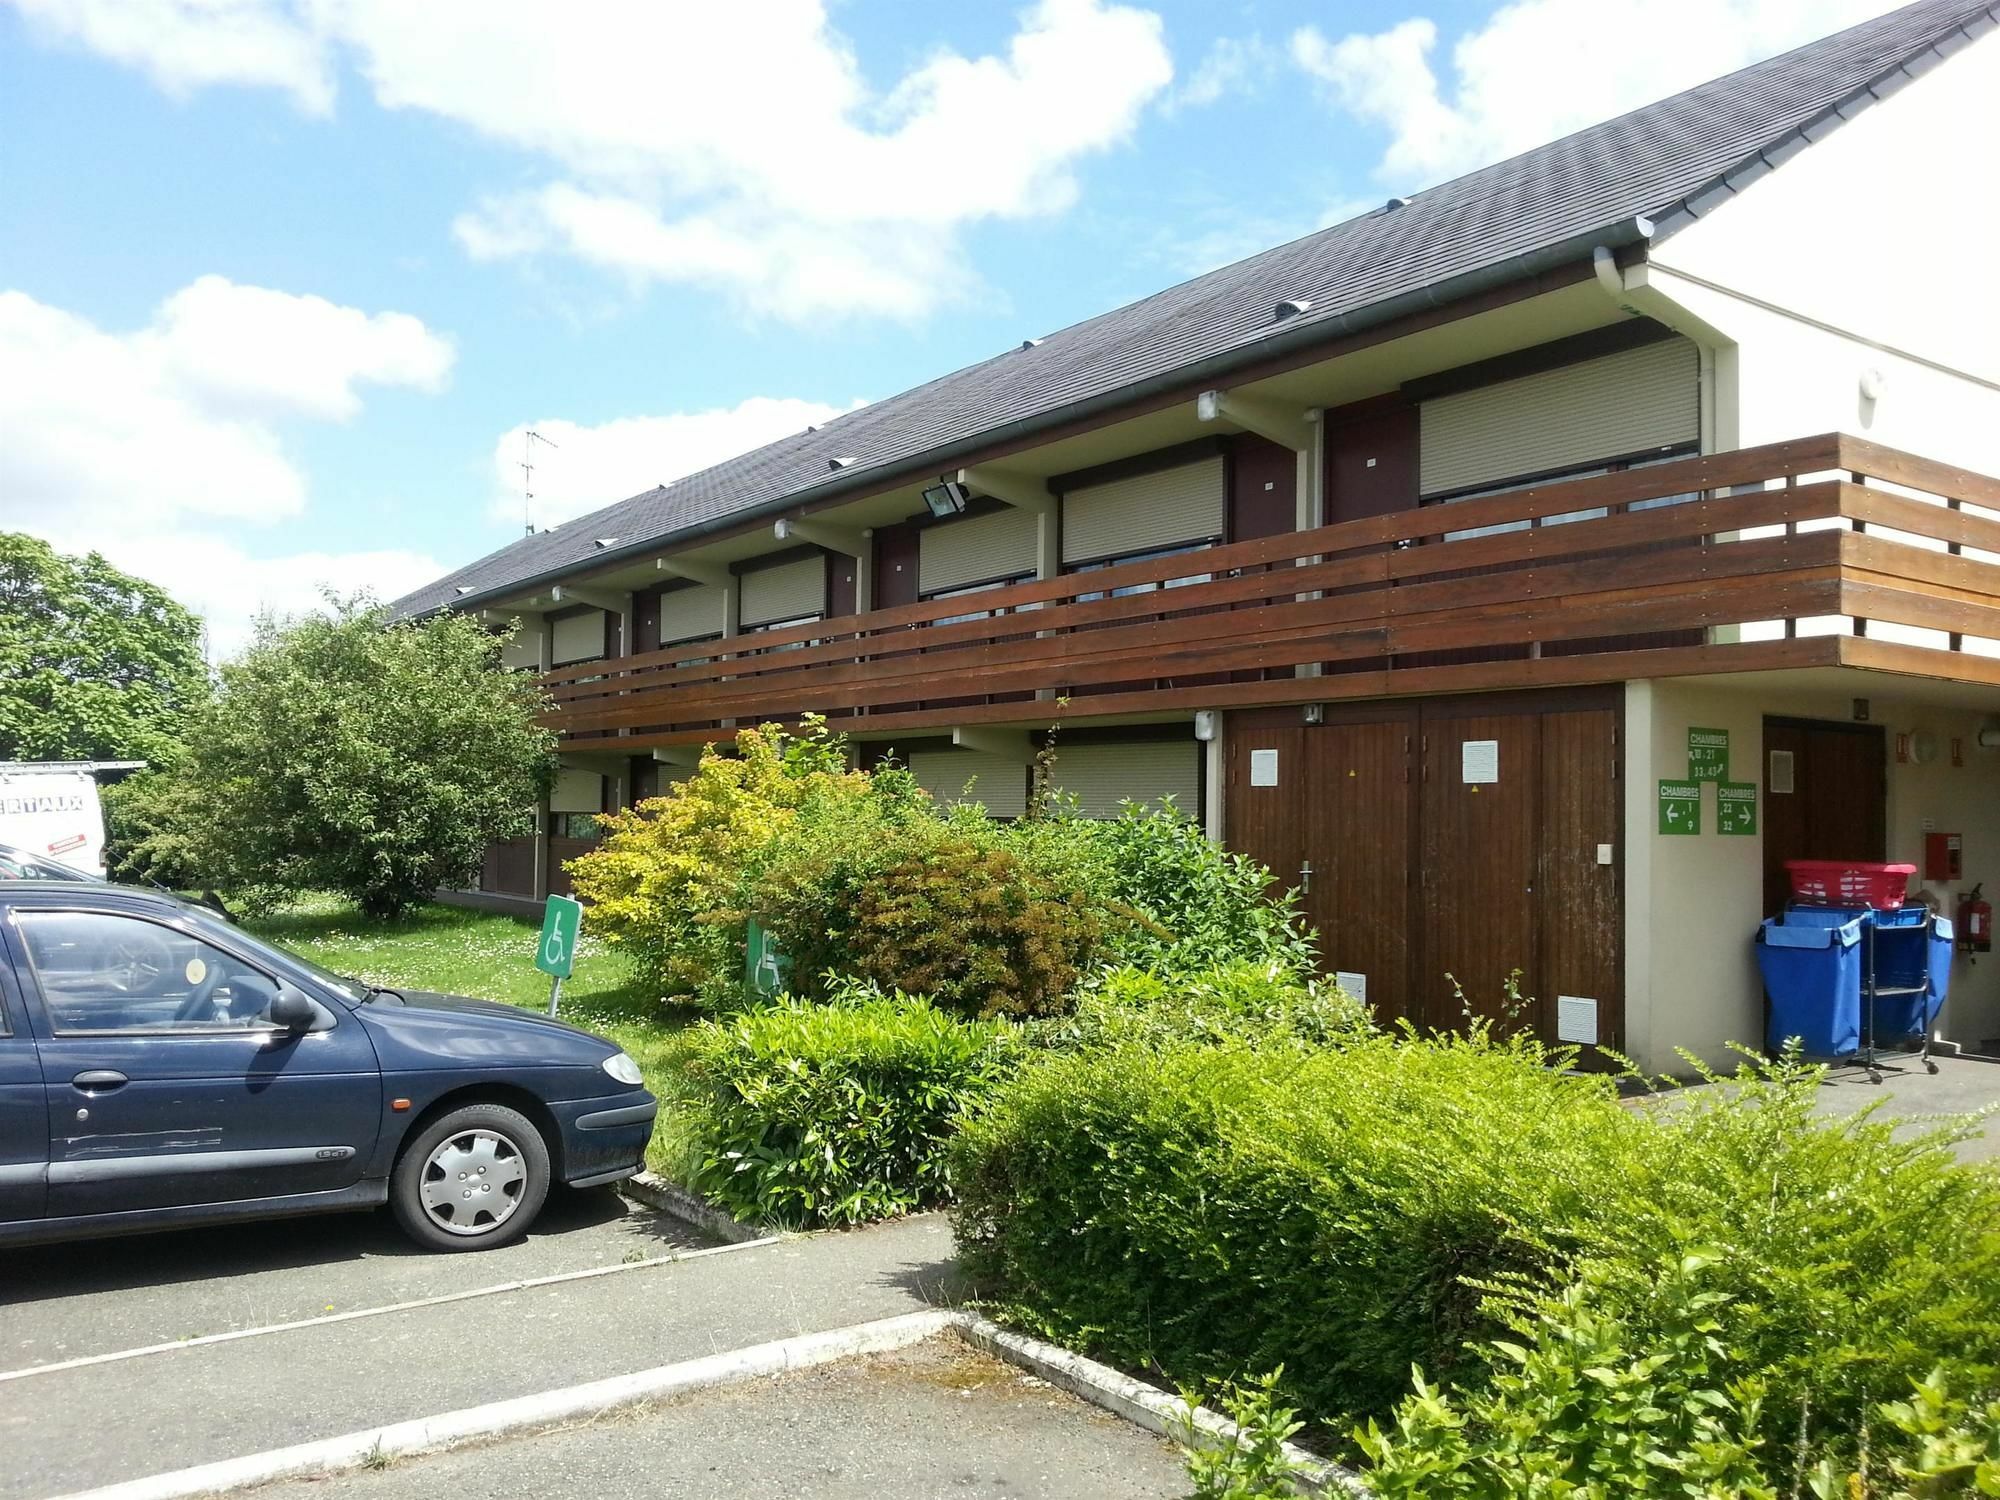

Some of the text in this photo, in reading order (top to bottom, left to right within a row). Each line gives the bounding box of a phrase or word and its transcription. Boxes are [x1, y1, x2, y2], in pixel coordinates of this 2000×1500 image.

[1690, 734, 1727, 745] CHAMBRES
[1660, 785, 1699, 798] CHAMBRES
[1719, 788, 1755, 799] CHAMBRES
[1687, 820, 1694, 830] 9
[1723, 820, 1733, 831] 32
